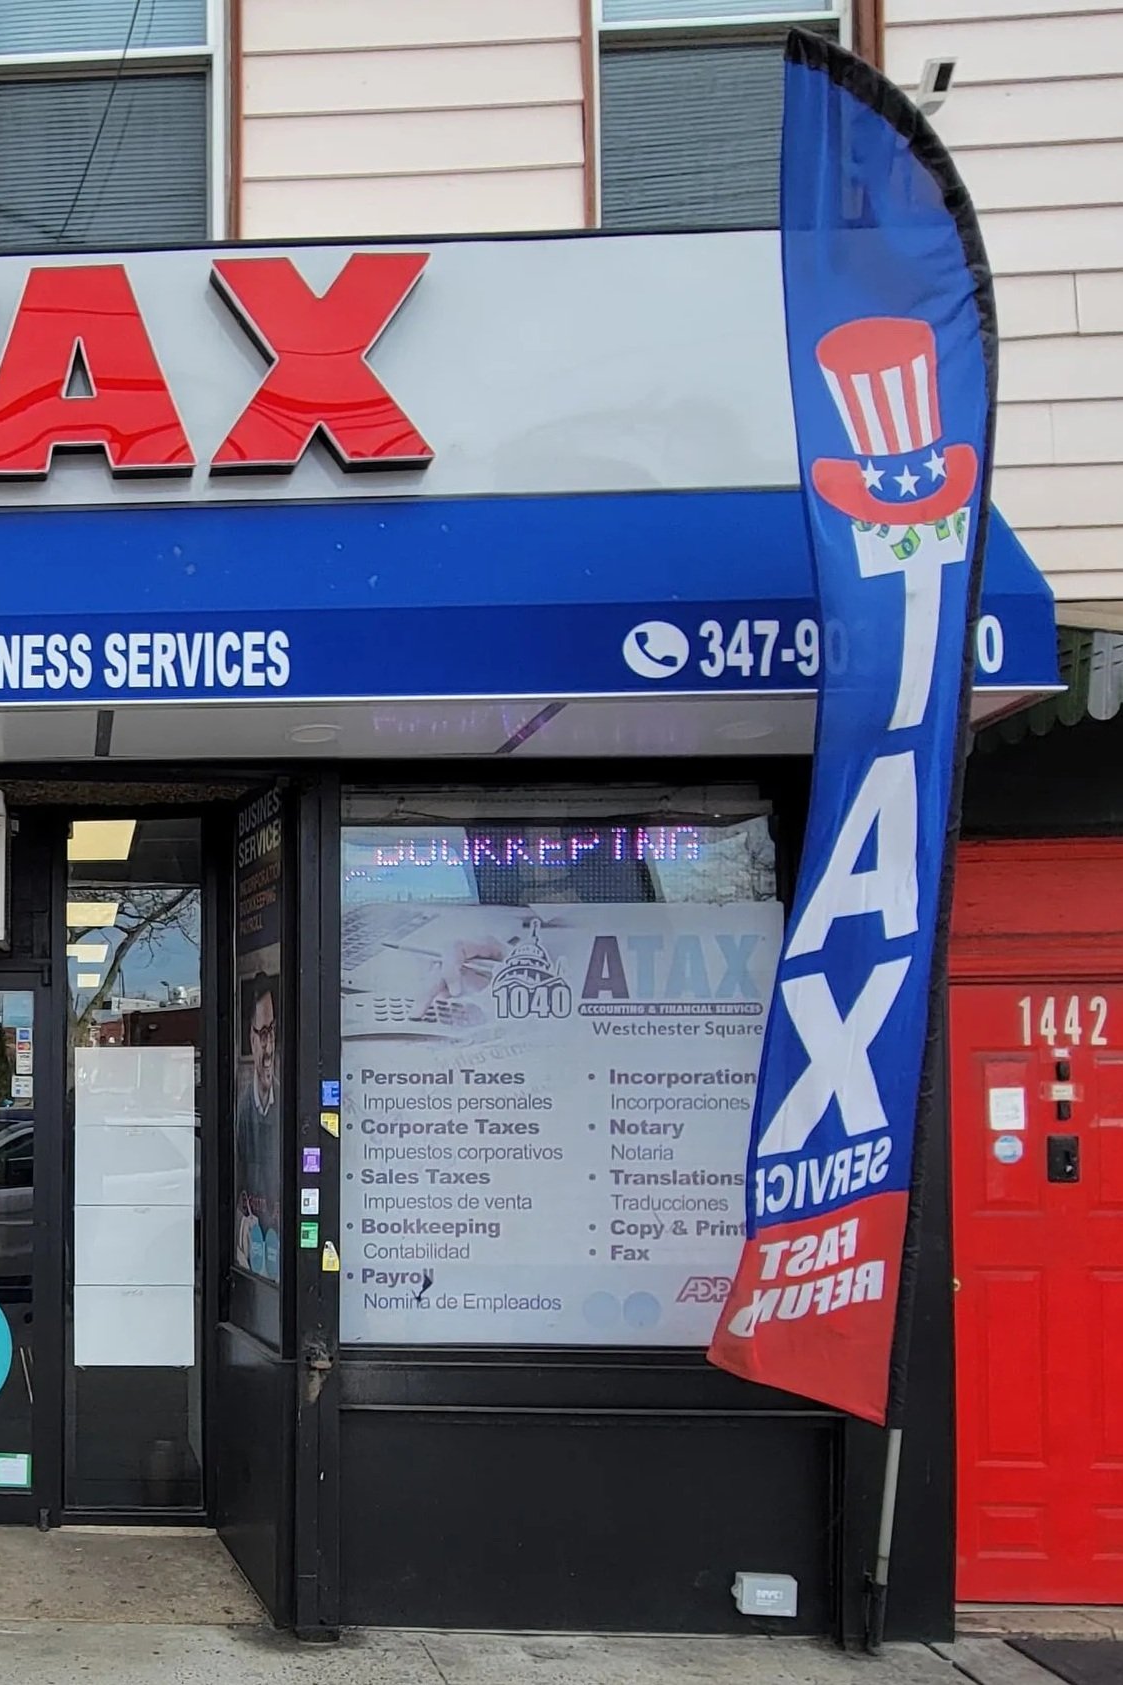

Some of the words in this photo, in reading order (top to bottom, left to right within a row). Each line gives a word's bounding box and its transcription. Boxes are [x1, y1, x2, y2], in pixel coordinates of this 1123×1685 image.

[103, 629, 292, 689] SERVICES
[238, 787, 282, 837] BUSINES
[581, 934, 759, 1000] ATAX
[491, 985, 573, 1020] 1040
[580, 1004, 645, 1015] ACCOUNTING
[647, 1004, 656, 1014] &
[659, 1004, 712, 1014] FINANCIAL
[715, 1003, 762, 1014] SERVICES
[592, 1020, 701, 1036] Westchester
[705, 1020, 763, 1038] Square
[1019, 996, 1109, 1046] 1442
[361, 1069, 454, 1086] Personal
[460, 1069, 525, 1085] Taxes
[363, 1093, 452, 1113] Impuestos
[457, 1093, 552, 1113] personales
[610, 1093, 750, 1114] Incorporaciones
[361, 1119, 469, 1138] Corporate
[475, 1119, 540, 1135] Taxes
[610, 1119, 684, 1139] Notary
[363, 1143, 452, 1164] Impuestos
[457, 1143, 563, 1164] corporativos
[361, 1168, 419, 1185] Sales
[425, 1168, 491, 1185] Taxes
[610, 1169, 745, 1186] Translations
[363, 1193, 452, 1214] Impuestos
[458, 1193, 480, 1210] de
[484, 1194, 532, 1211] venta
[611, 1194, 729, 1212] Traducciones
[361, 1218, 501, 1238] Bookkeeping
[610, 1220, 664, 1239] Copy
[672, 1220, 688, 1236] &
[696, 1219, 747, 1237] Print
[363, 1243, 470, 1260] Contabilidad
[610, 1244, 650, 1261] Fax
[676, 1276, 733, 1303] ADP
[363, 1293, 430, 1310] Nomina
[435, 1293, 457, 1310] de
[463, 1293, 562, 1313] Empleados
